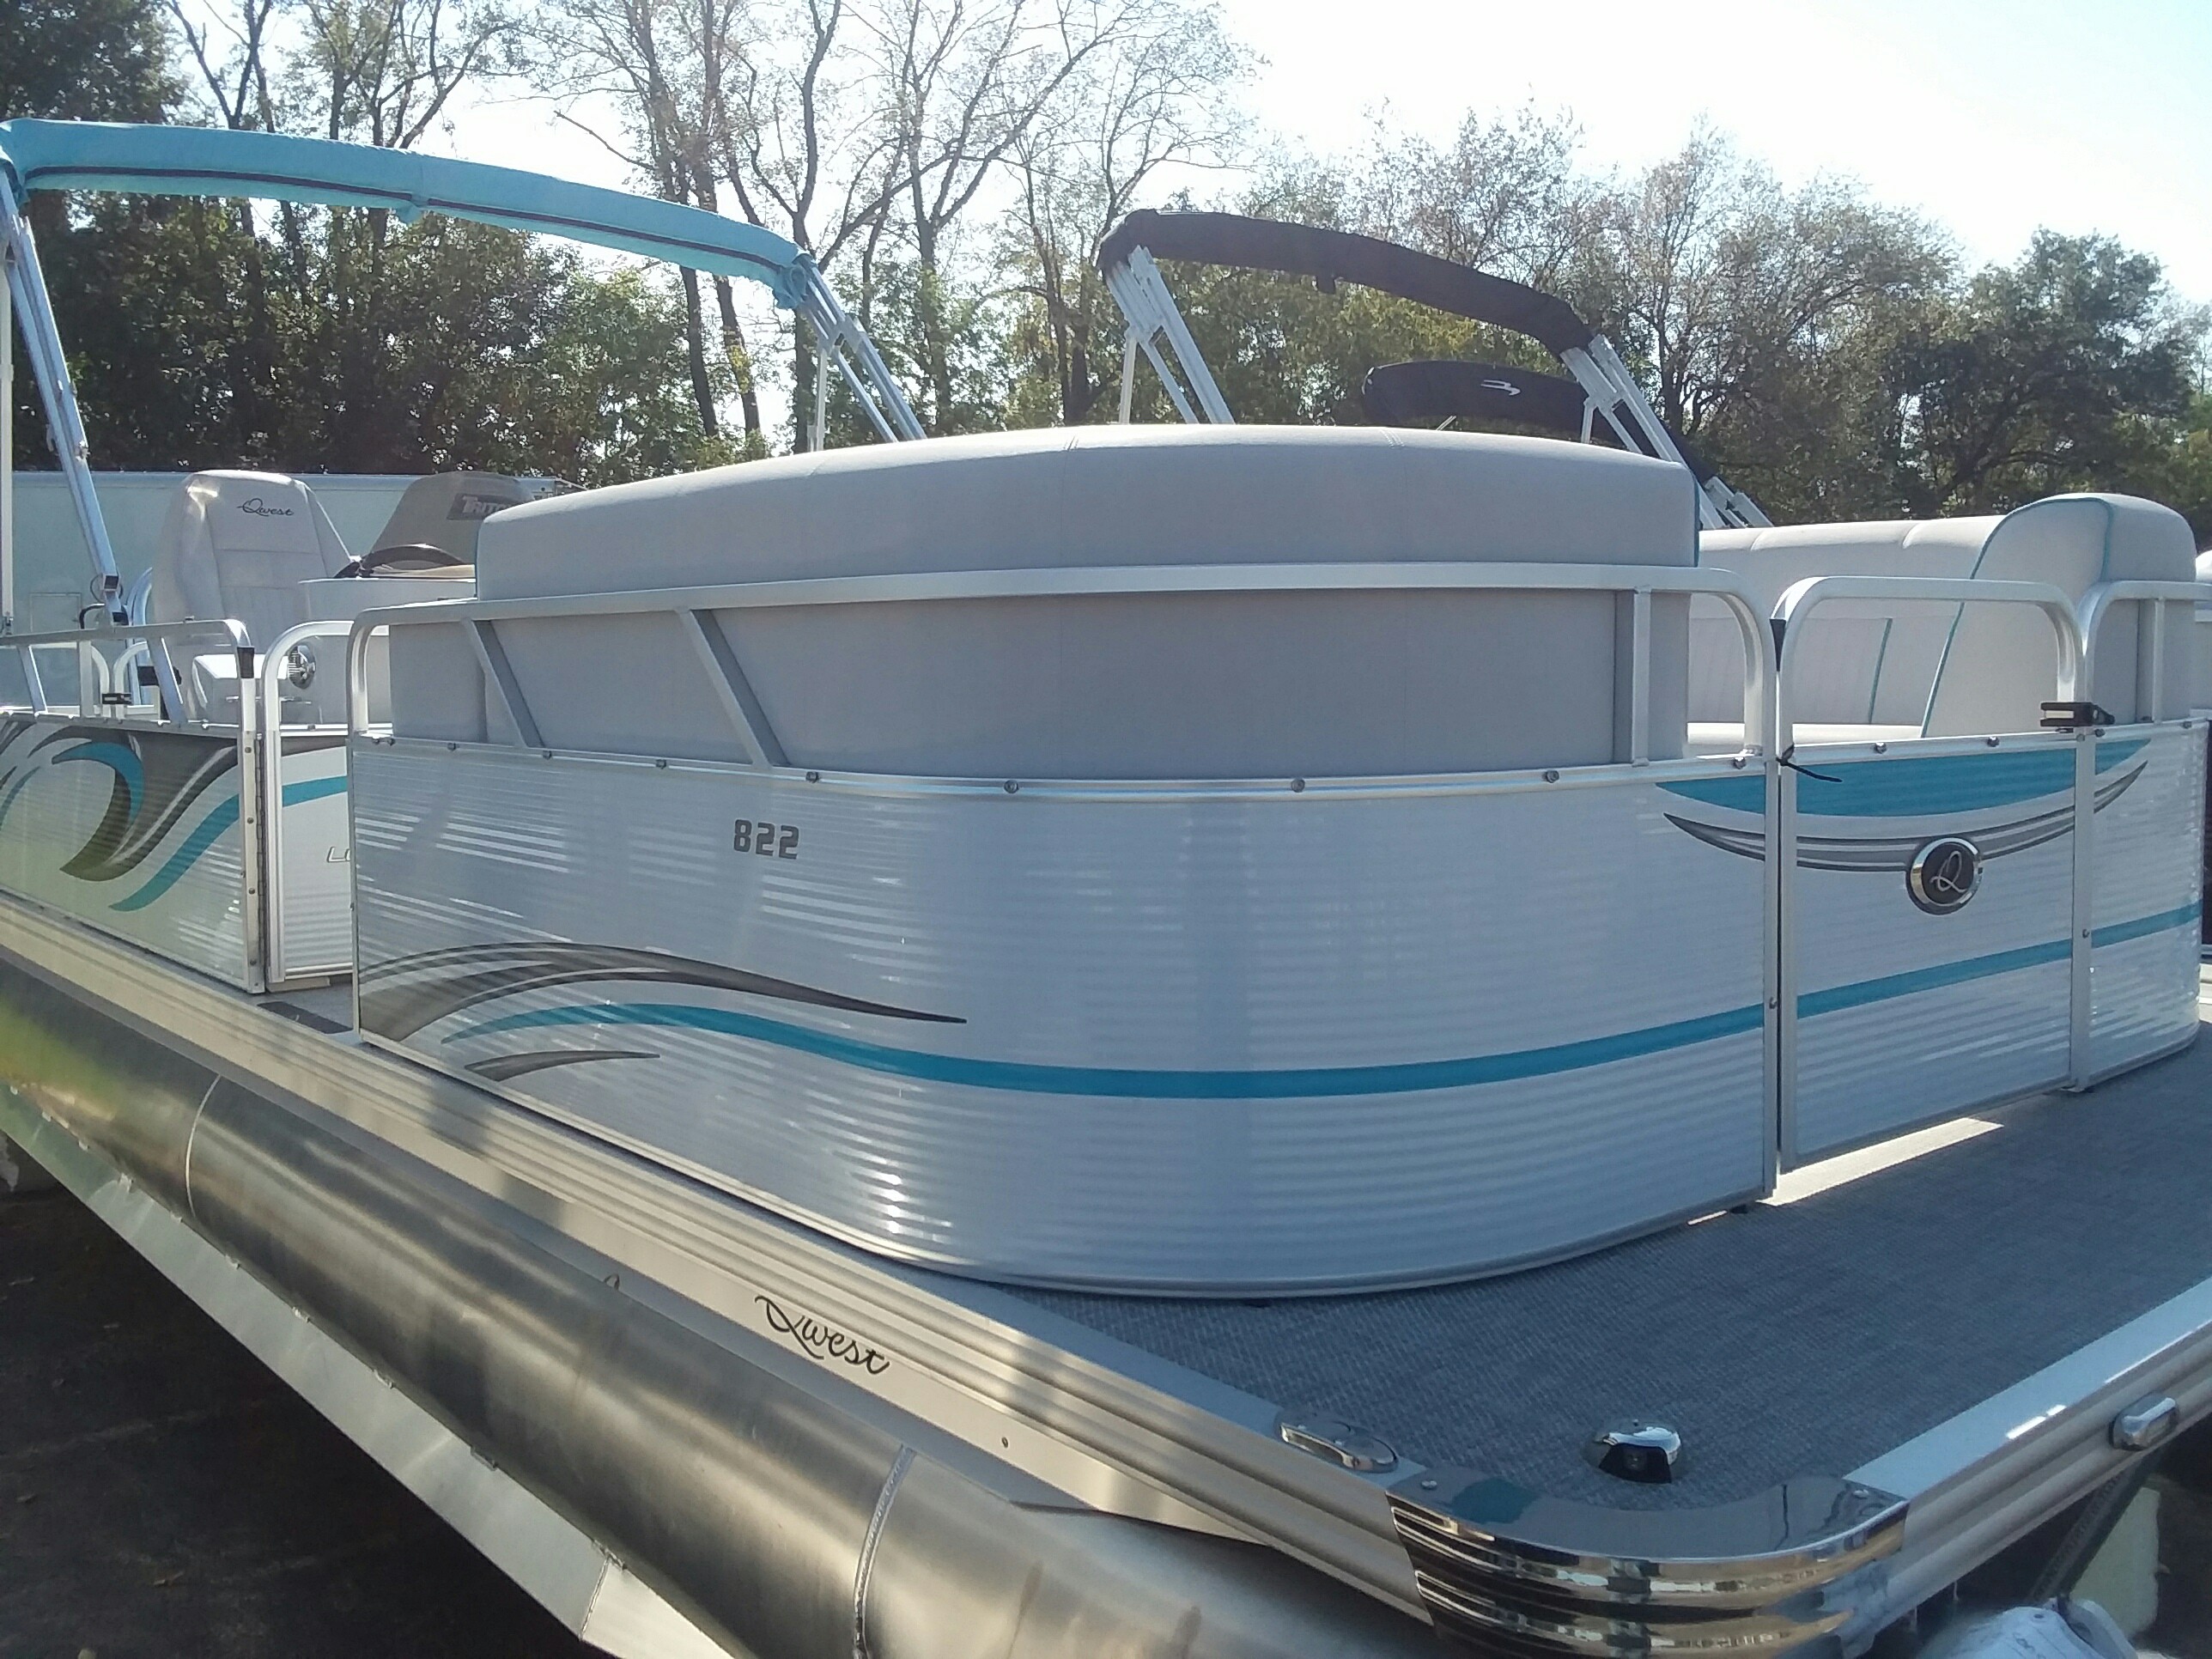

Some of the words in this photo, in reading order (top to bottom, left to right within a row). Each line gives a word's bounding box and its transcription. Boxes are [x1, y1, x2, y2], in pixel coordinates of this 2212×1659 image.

[236, 498, 295, 517] Qwest
[733, 818, 799, 860] 822
[754, 1295, 890, 1375] Qwest
